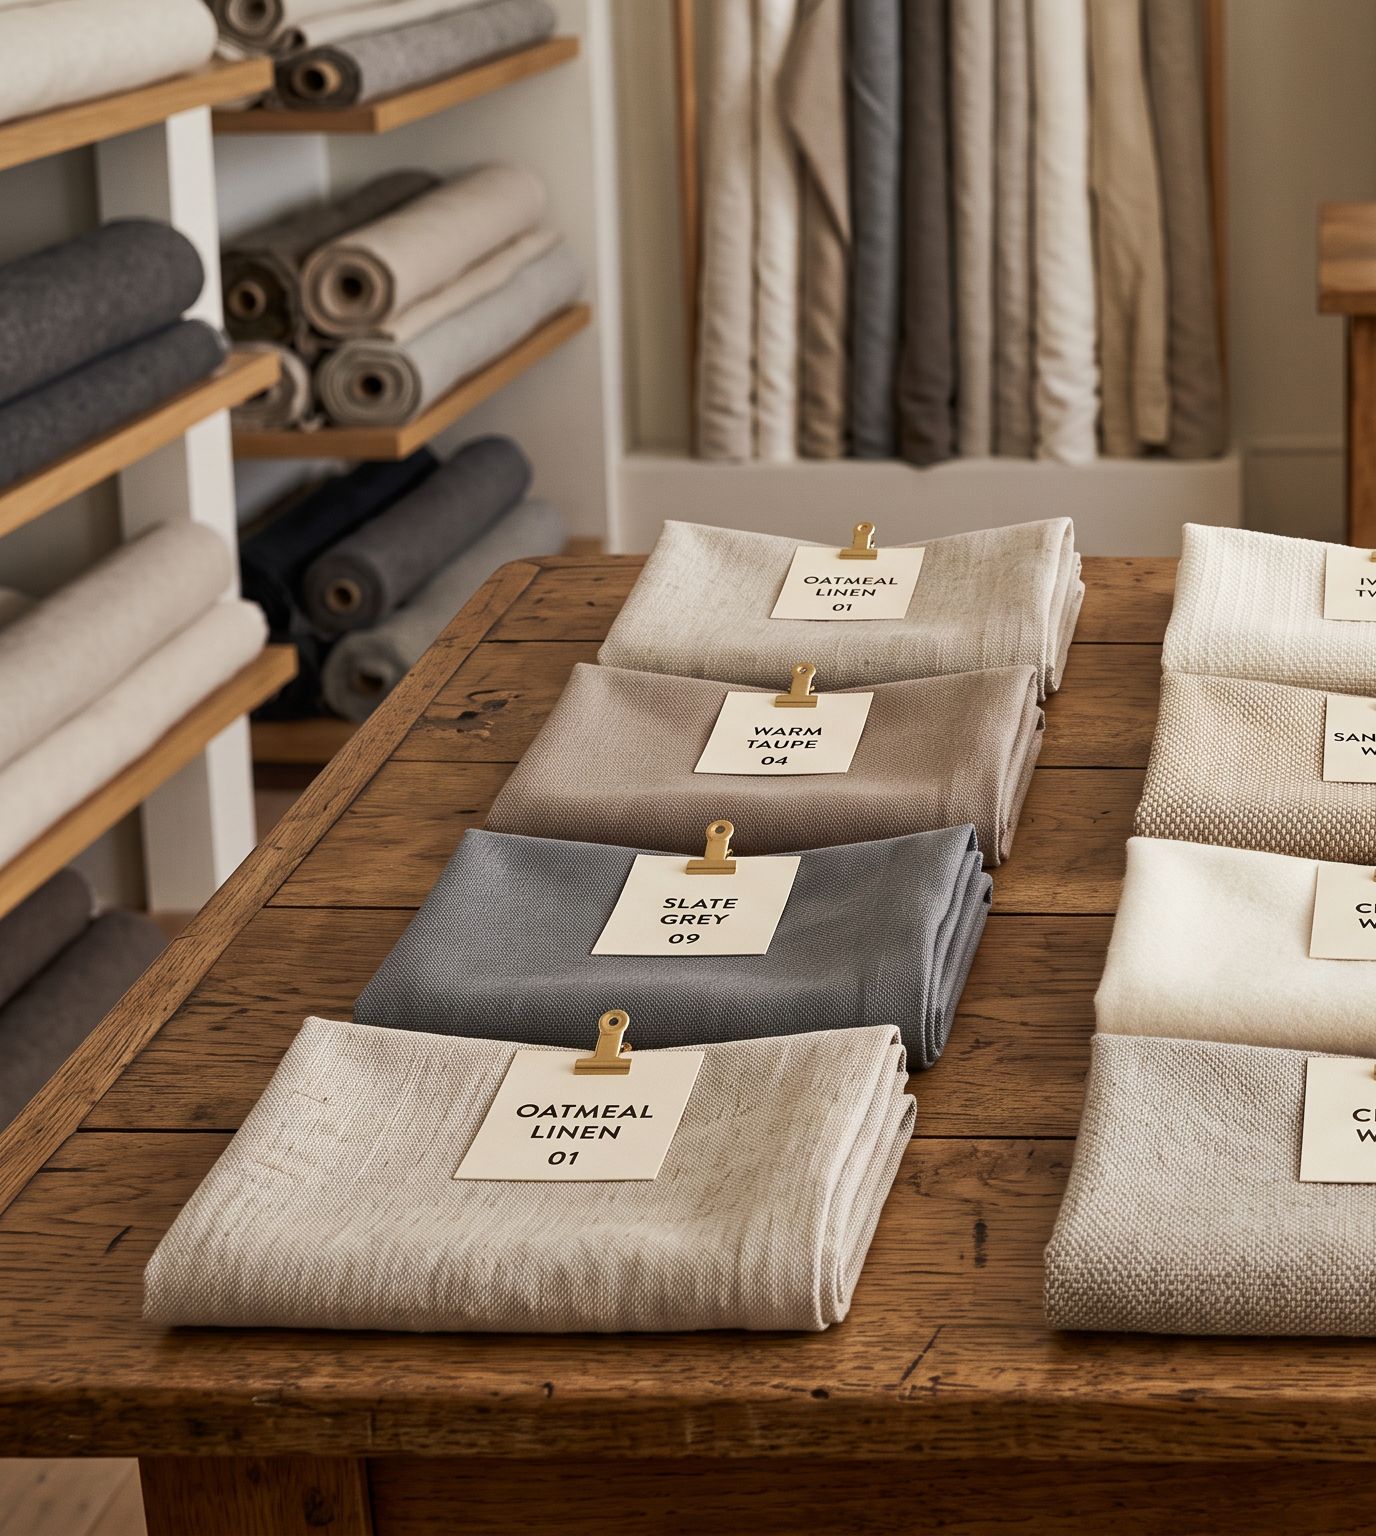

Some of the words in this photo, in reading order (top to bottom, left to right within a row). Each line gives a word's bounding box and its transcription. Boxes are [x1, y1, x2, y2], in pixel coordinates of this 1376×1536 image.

[803, 575, 899, 586] OATMEAL
[815, 588, 877, 597] LINEN
[832, 603, 853, 612] 01
[754, 726, 823, 737] WARM
[746, 739, 819, 750] TAUPE
[760, 755, 788, 766] 04
[662, 897, 739, 910] SLATE
[659, 913, 730, 926] GREY
[668, 933, 701, 945] 09
[515, 1103, 654, 1119] OATMEAL
[530, 1124, 622, 1140] LINEN
[547, 1150, 580, 1166] 01
